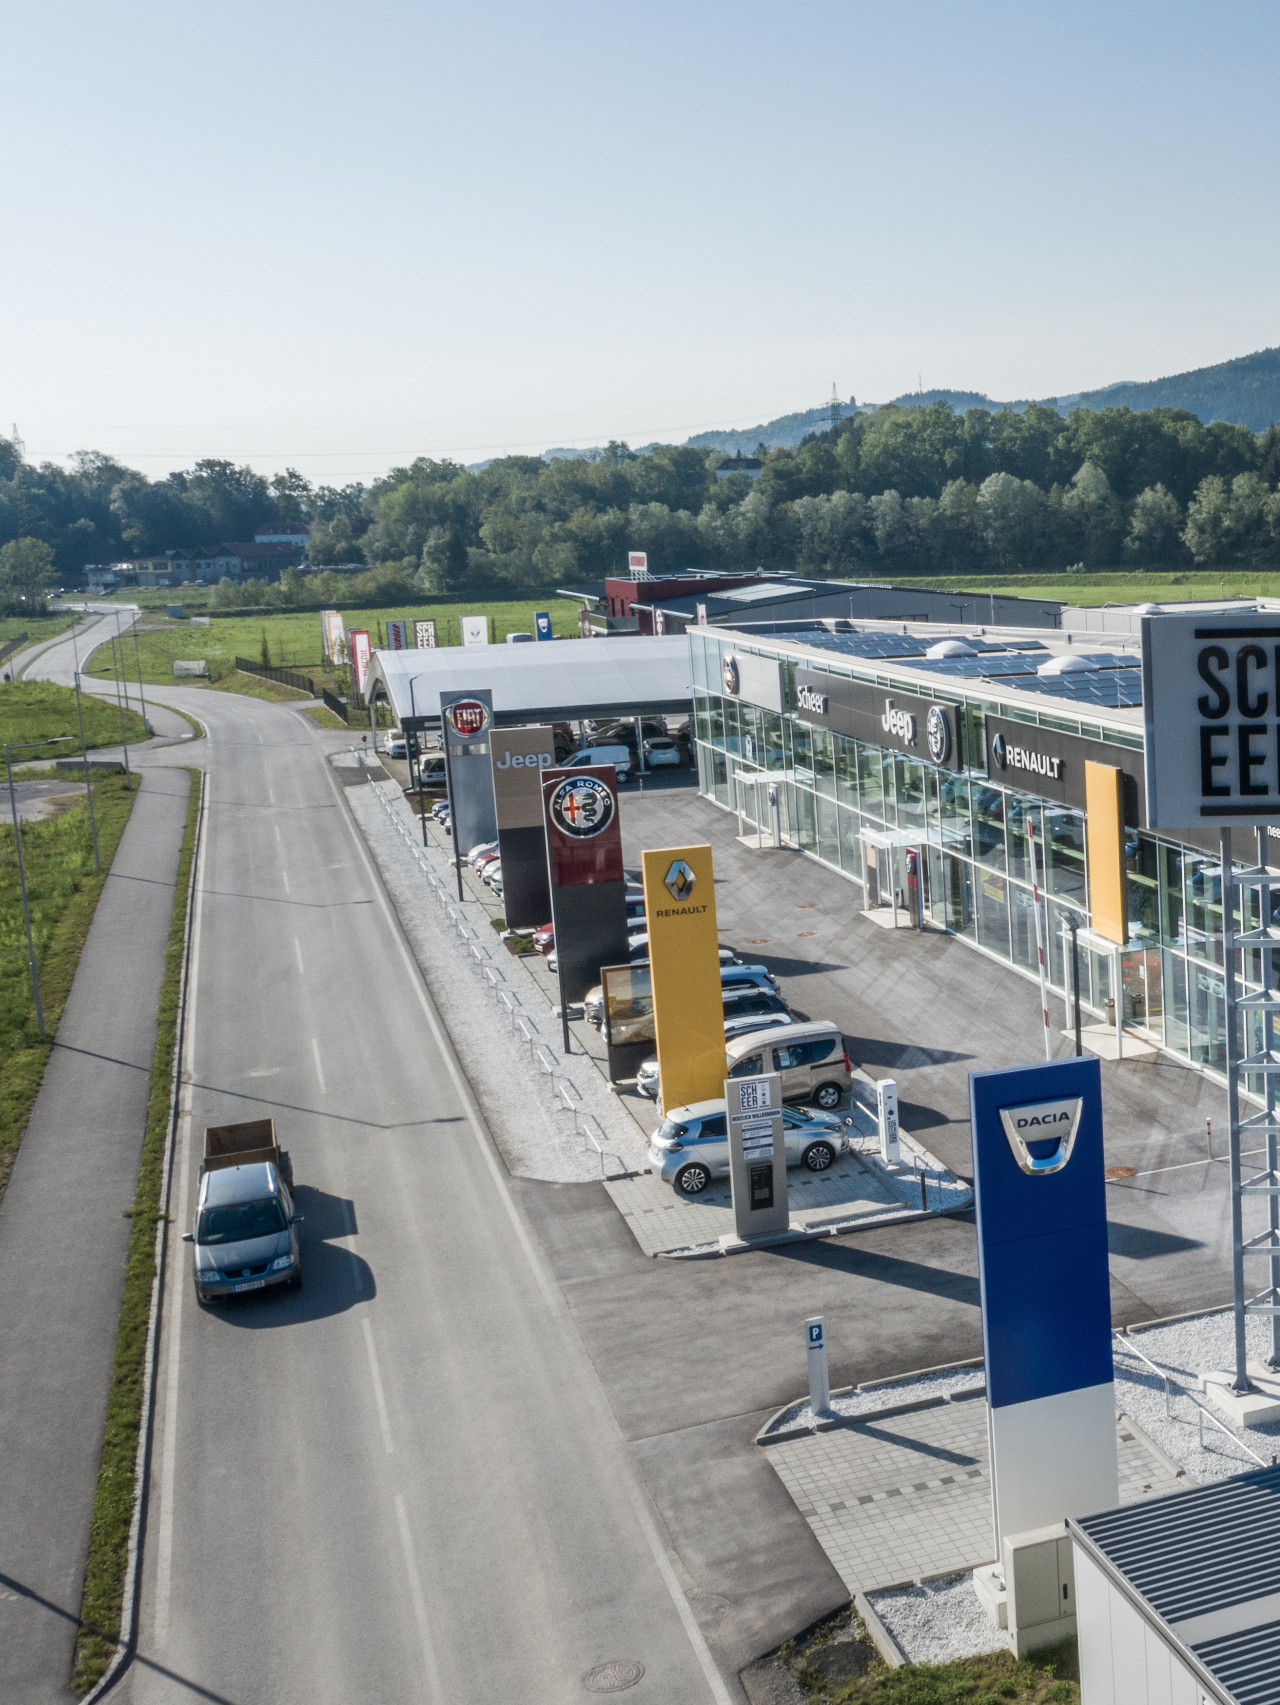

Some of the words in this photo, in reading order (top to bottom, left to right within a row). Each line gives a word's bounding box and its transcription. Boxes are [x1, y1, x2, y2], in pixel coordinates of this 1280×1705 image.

[415, 624, 435, 637] SCH
[416, 636, 436, 648] EER
[797, 685, 825, 714] Scheer
[456, 708, 482, 728] FIAT
[881, 698, 915, 746] Jeep
[496, 751, 552, 769] Jeep
[1005, 745, 1060, 779] RENAULT
[554, 784, 573, 811] ALFA
[576, 780, 612, 806] ROMEO
[656, 905, 708, 918] RENAULT
[740, 1084, 758, 1097] SCH
[741, 1095, 759, 1108] EER
[1017, 1111, 1071, 1128] DACIA
[812, 1327, 820, 1340] P
